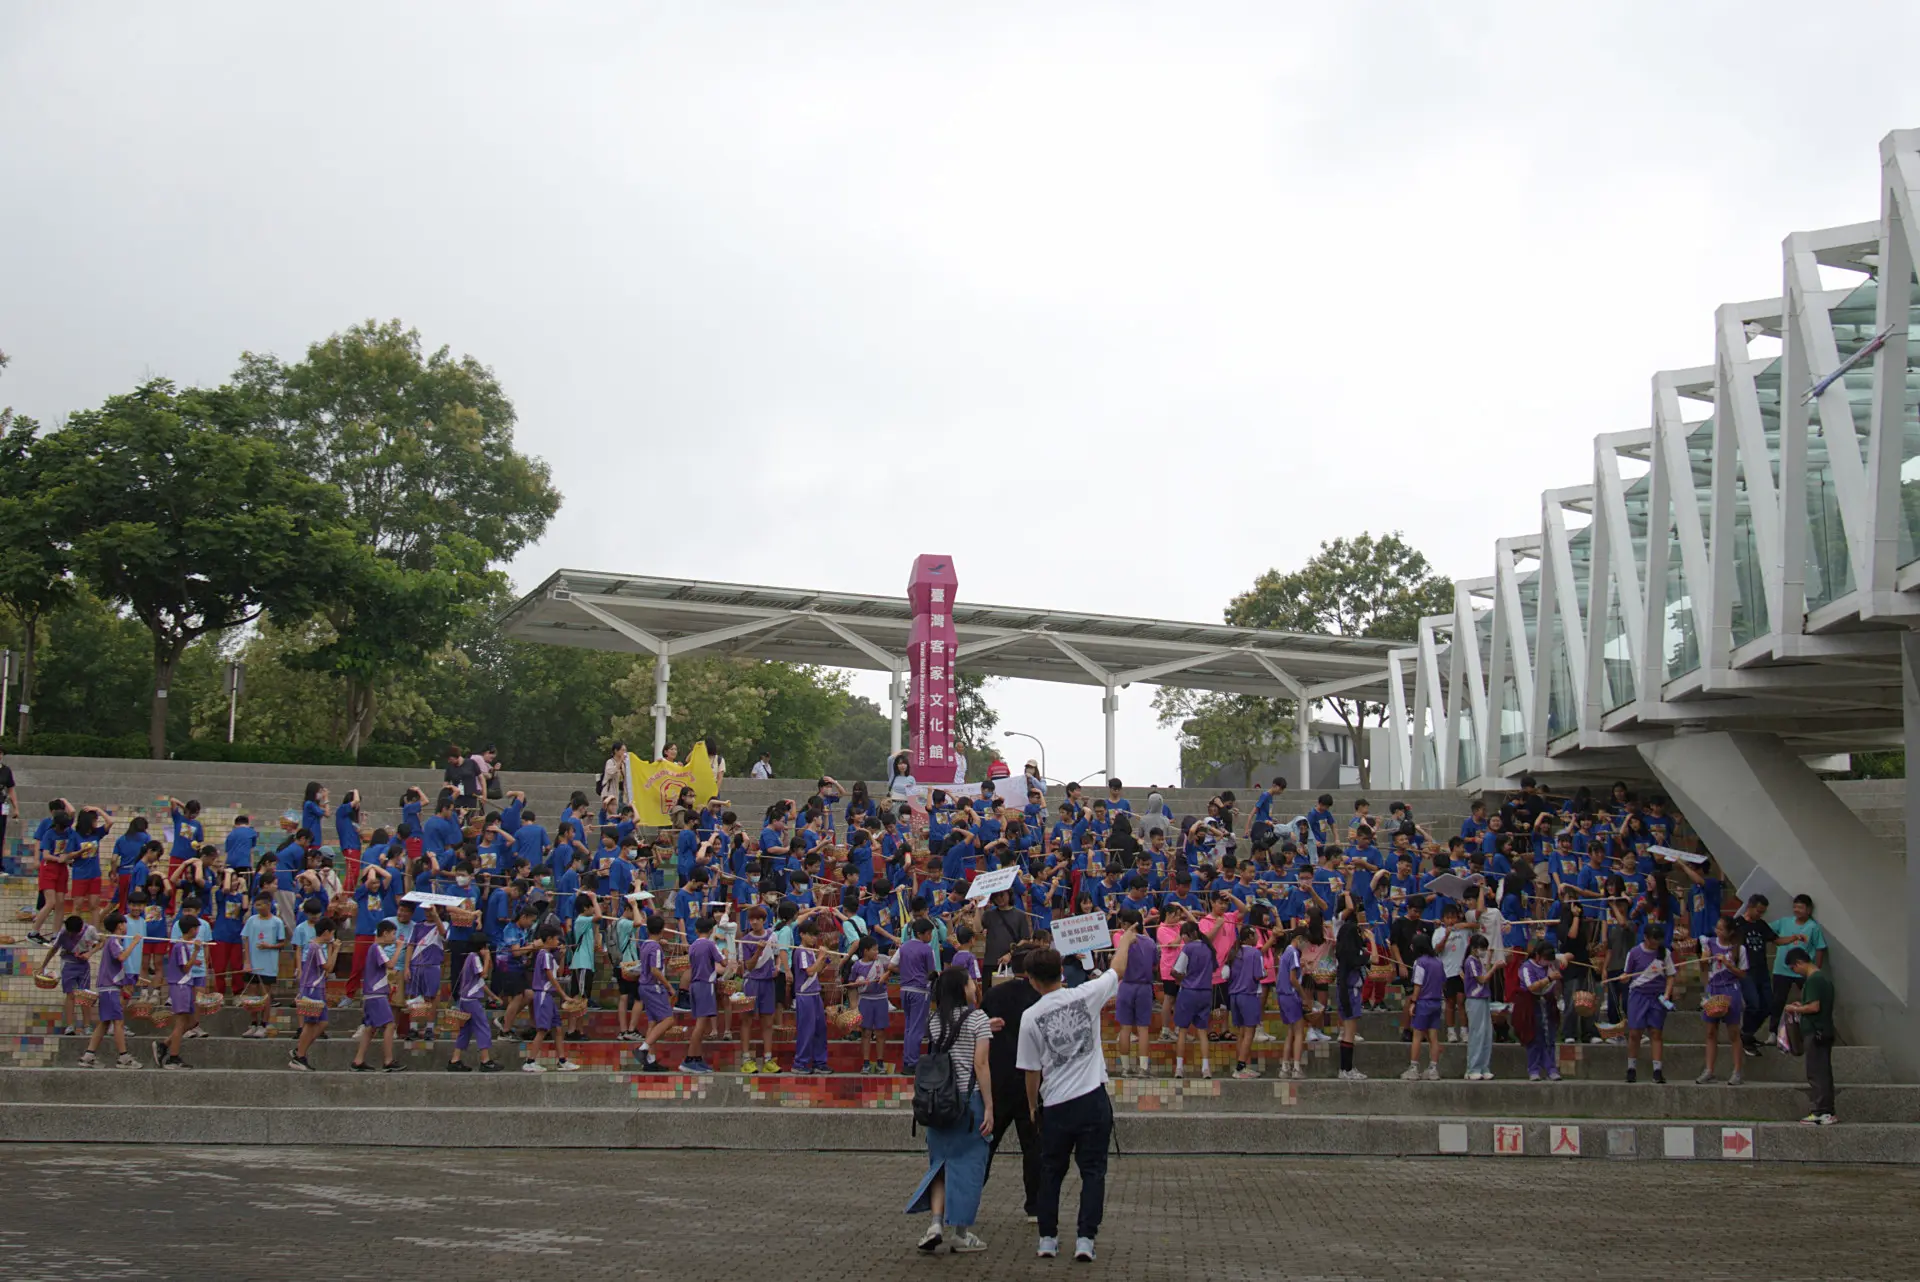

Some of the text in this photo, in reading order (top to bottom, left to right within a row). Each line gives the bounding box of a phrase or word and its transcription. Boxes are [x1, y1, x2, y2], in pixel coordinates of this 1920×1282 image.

[929, 588, 944, 759] 臺灣客家文化館
